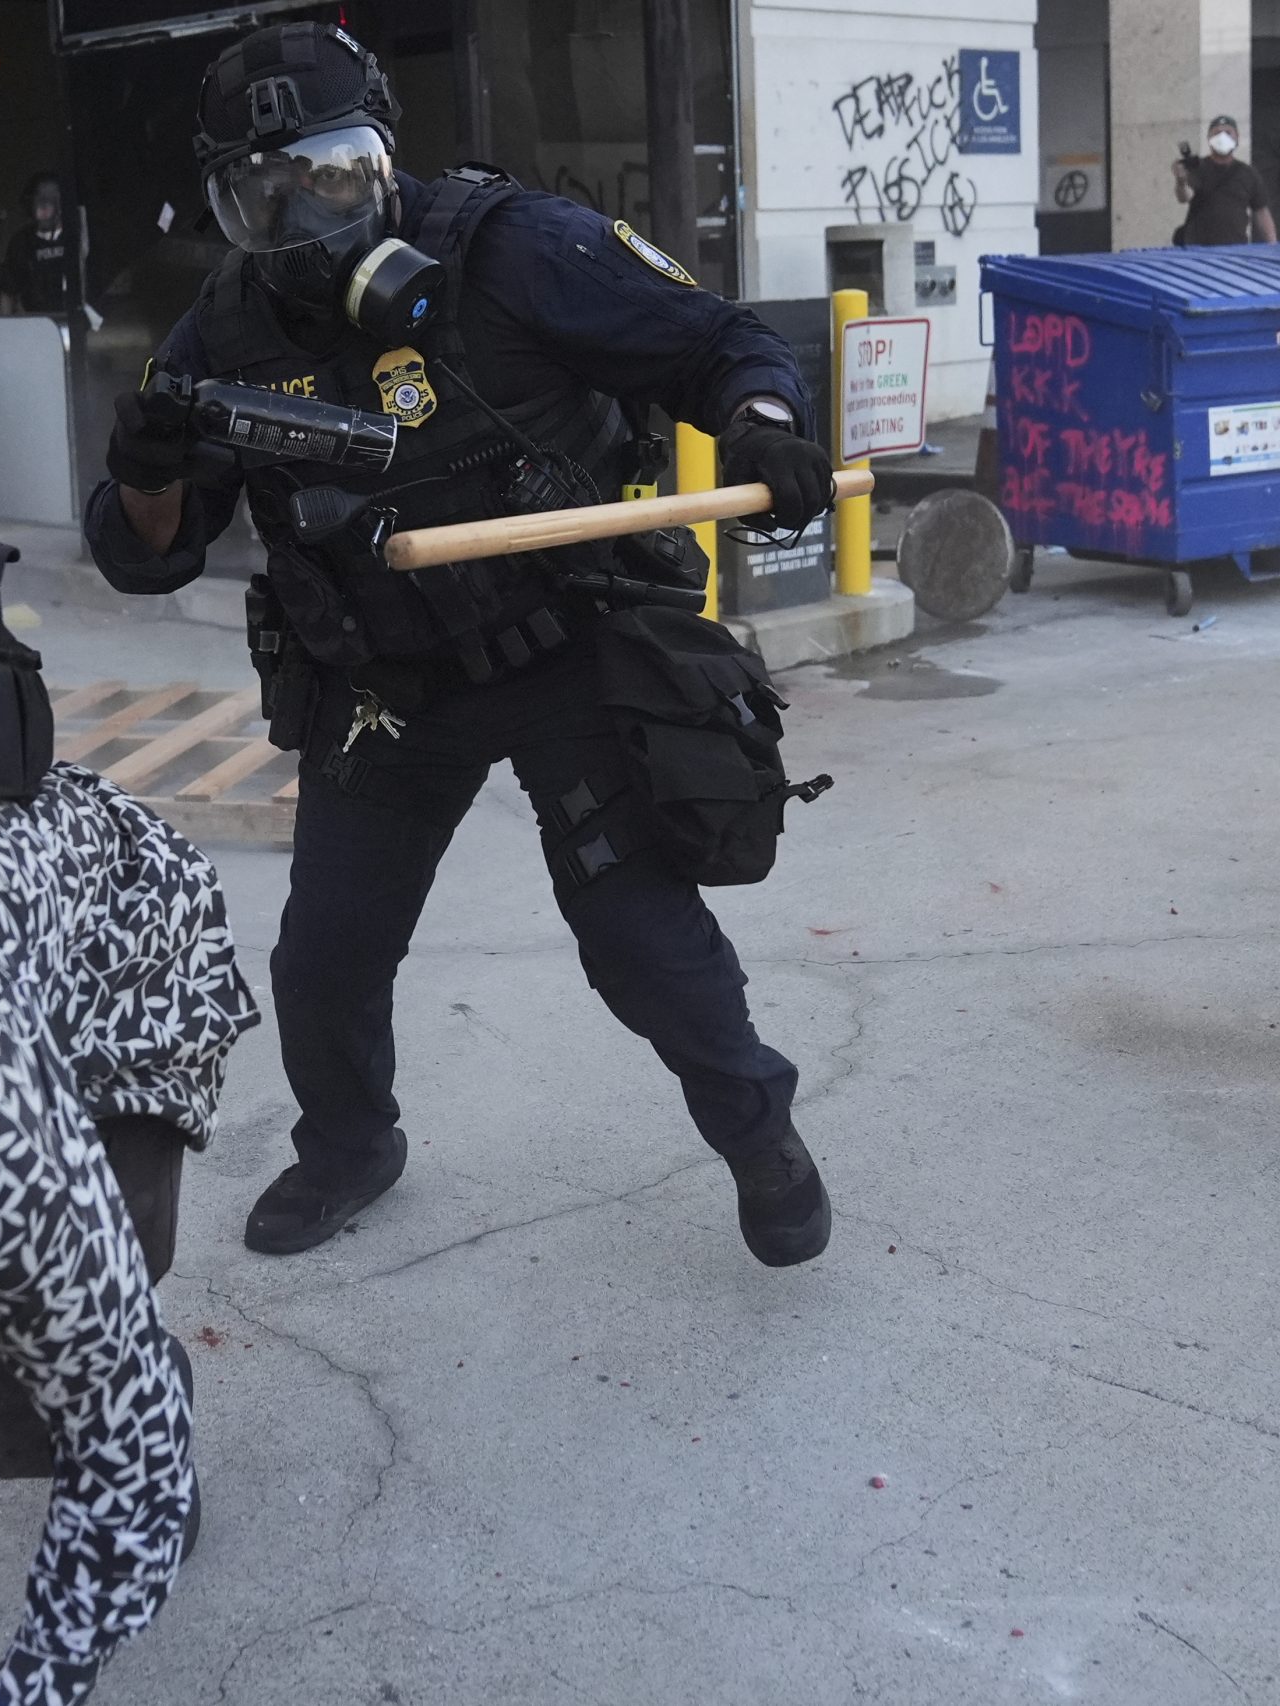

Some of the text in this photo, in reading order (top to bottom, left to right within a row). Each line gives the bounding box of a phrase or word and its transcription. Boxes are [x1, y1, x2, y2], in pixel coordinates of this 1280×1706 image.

[389, 366, 407, 377] DHS
[876, 373, 908, 389] GREEN
[869, 391, 917, 410] proceeding
